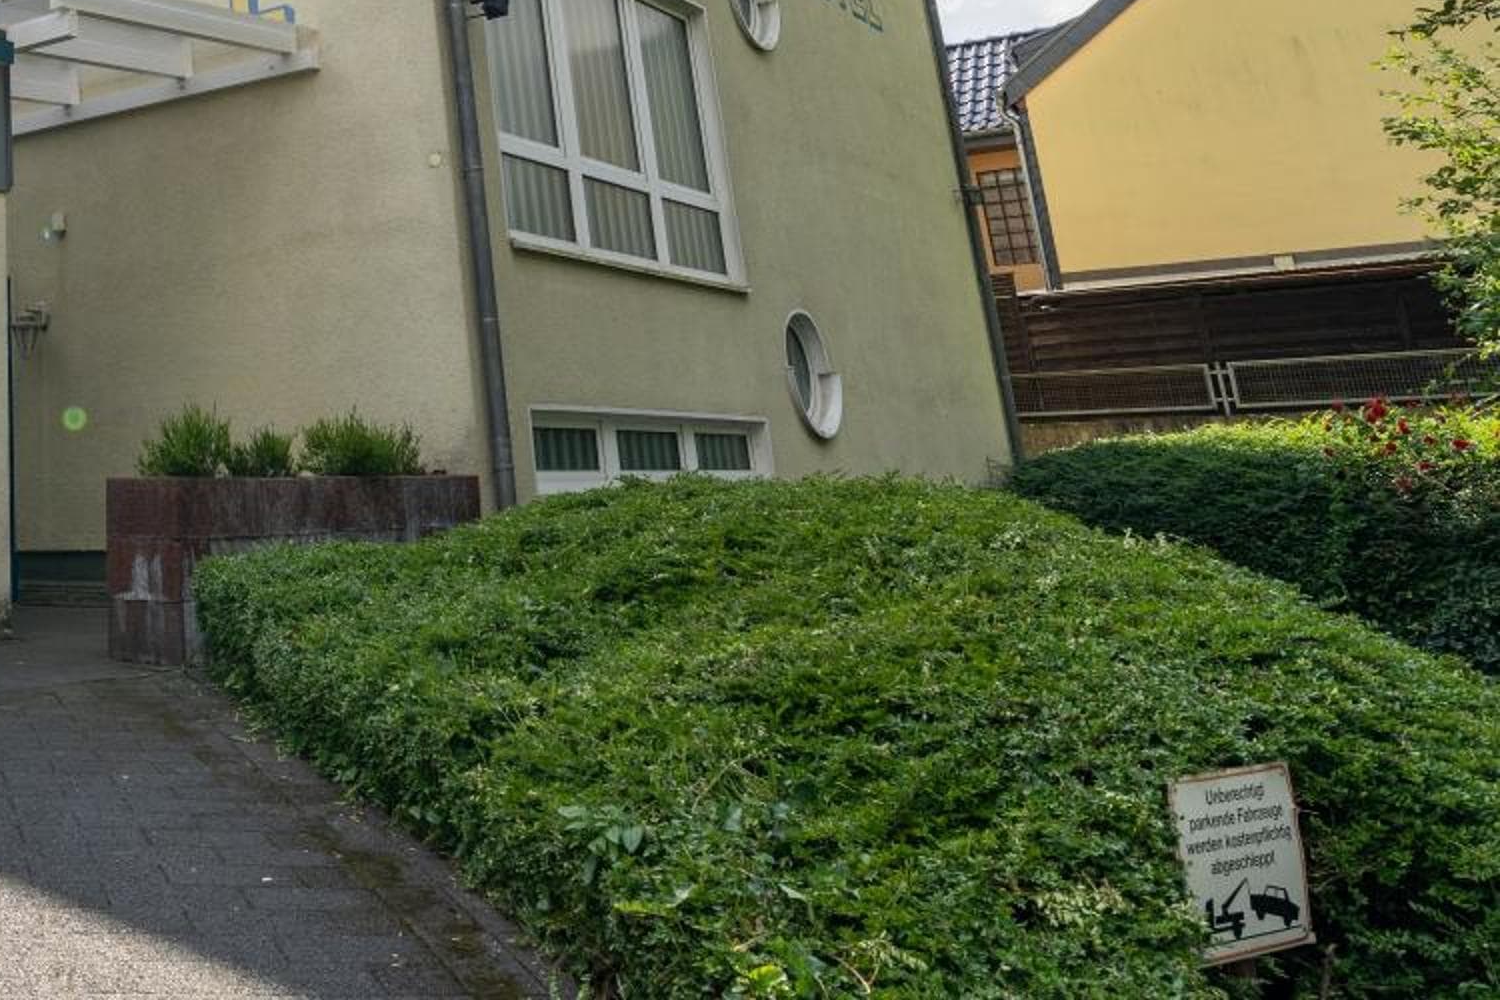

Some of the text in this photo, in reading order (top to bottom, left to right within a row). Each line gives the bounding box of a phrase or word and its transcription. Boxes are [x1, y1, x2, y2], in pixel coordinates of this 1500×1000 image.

[1189, 804, 1283, 833] parkende Fahrzeuge
[1186, 833, 1223, 855] werden
[1211, 851, 1275, 877] abgeschleppt
